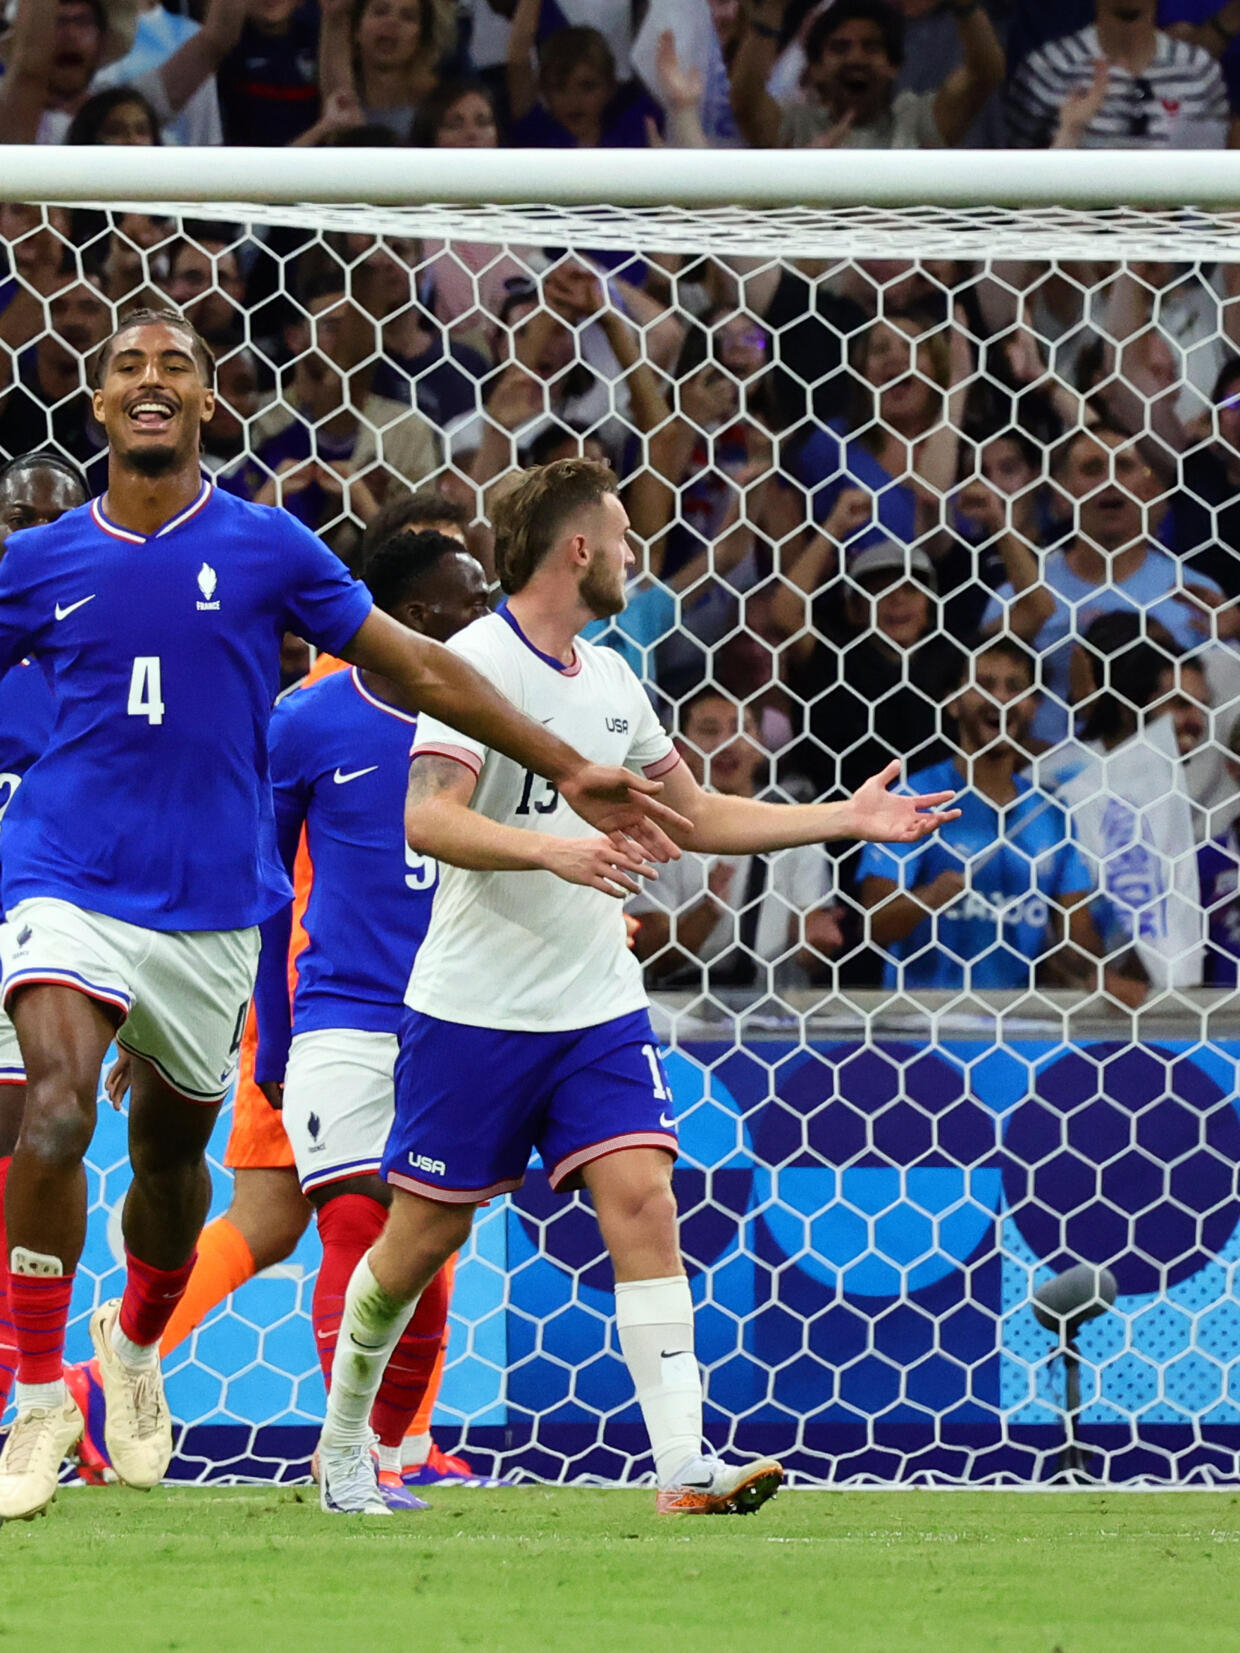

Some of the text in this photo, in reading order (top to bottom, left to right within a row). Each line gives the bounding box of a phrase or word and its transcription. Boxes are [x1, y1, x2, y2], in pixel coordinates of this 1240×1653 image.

[196, 600, 220, 611] FRANCE
[127, 656, 165, 725] 4
[605, 717, 628, 735] USA
[408, 1152, 446, 1176] USA
